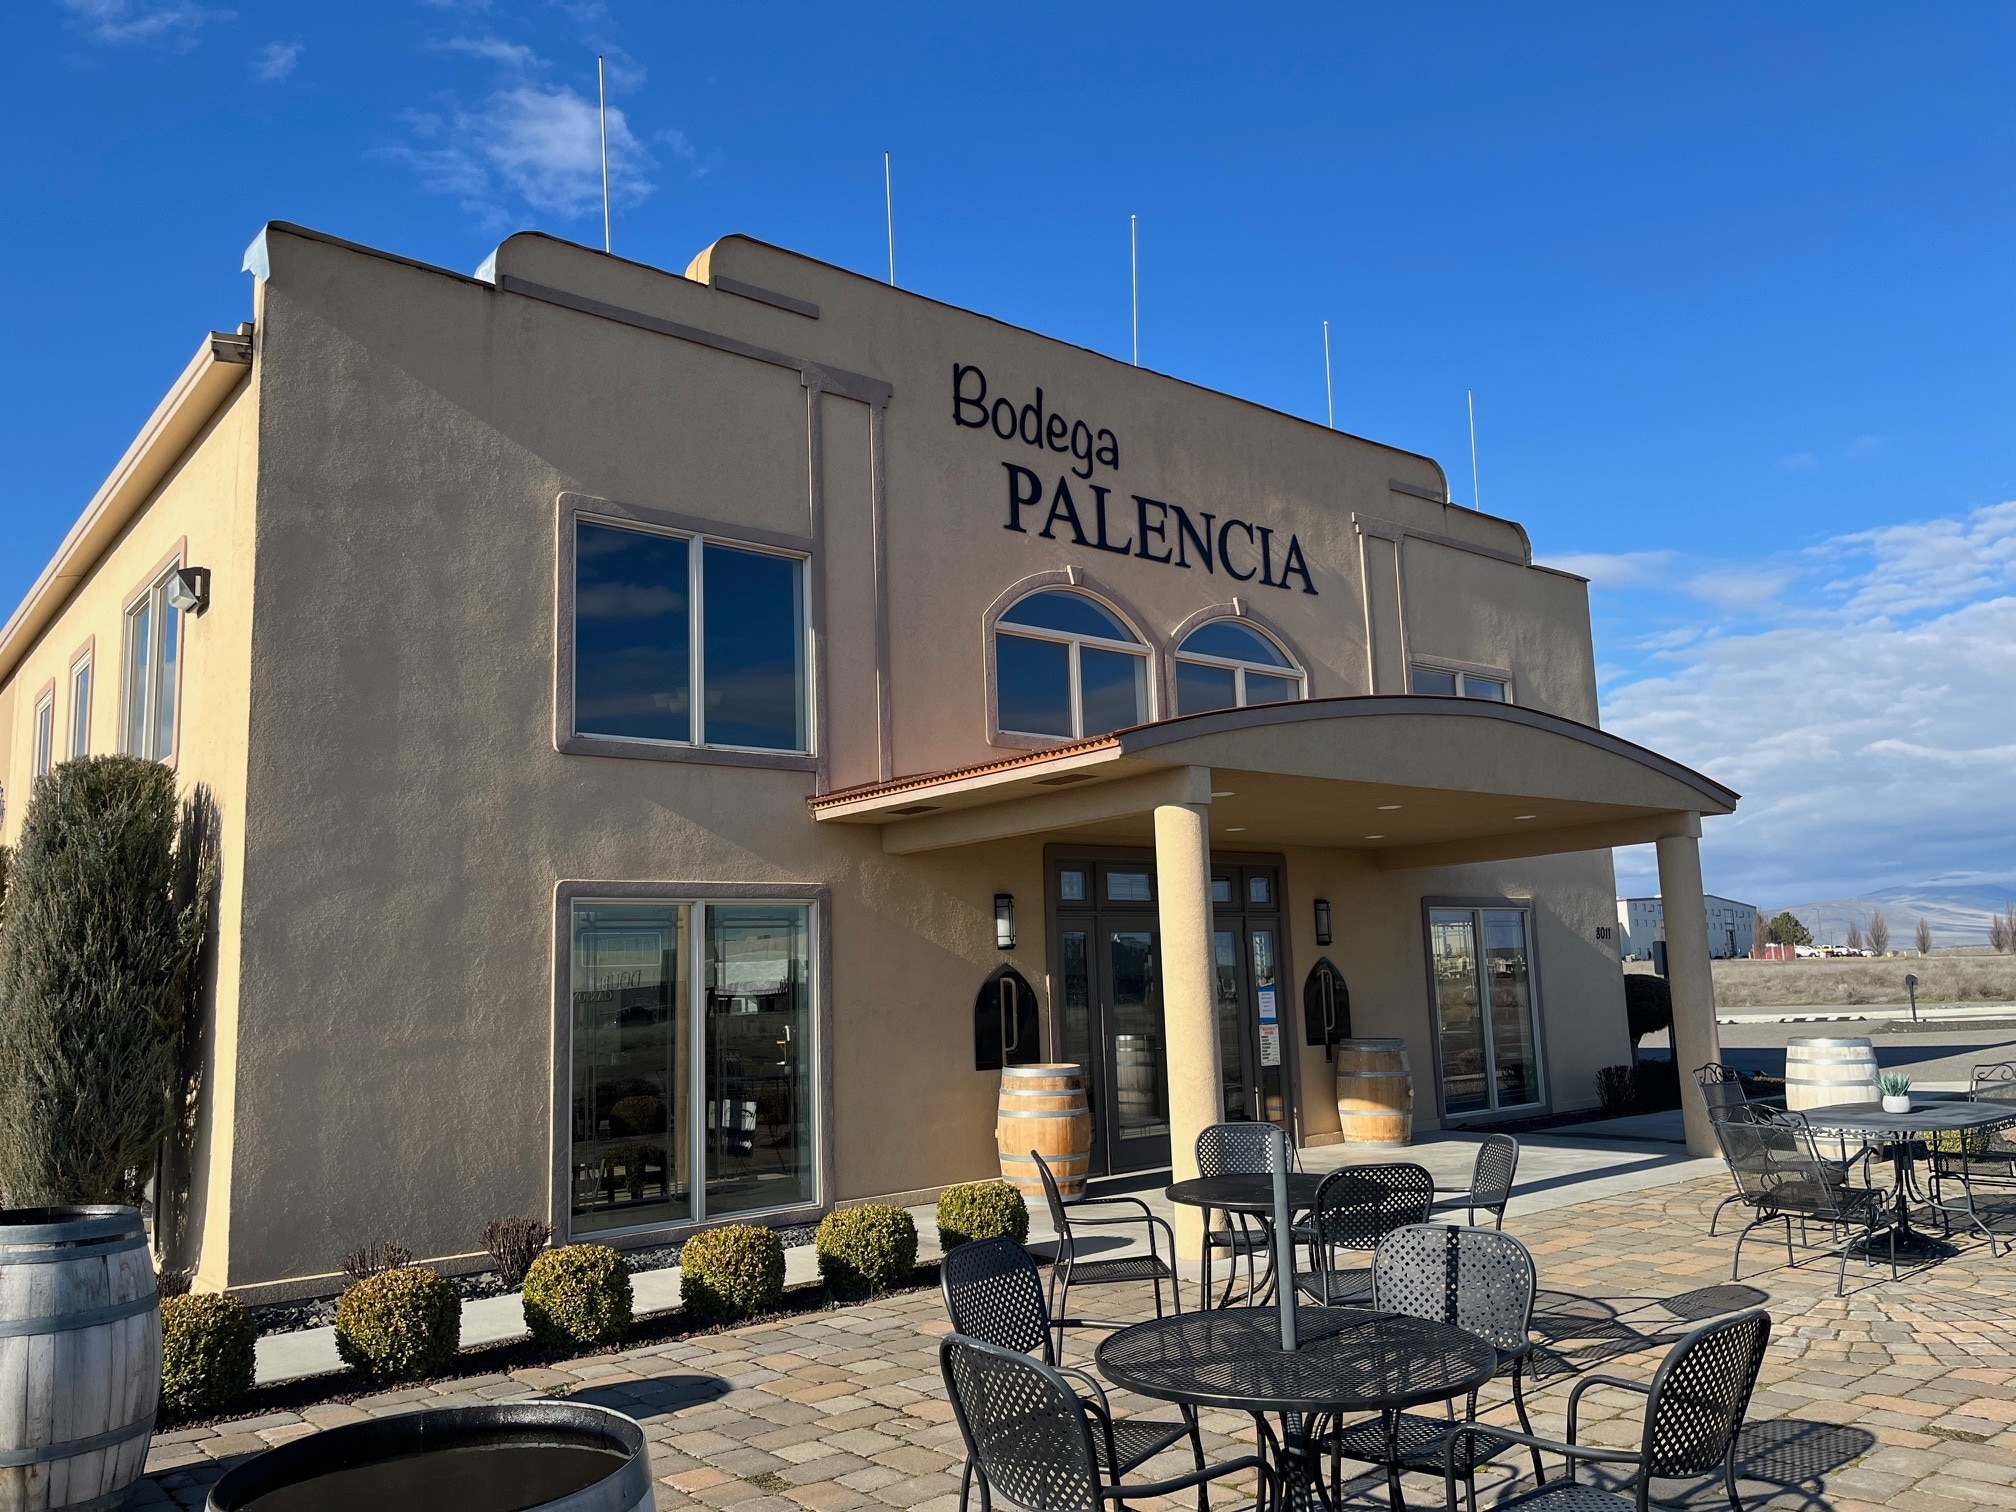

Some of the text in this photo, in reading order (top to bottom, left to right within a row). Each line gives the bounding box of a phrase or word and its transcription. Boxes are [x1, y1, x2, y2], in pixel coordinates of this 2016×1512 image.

[952, 362, 1119, 479] Bodega
[1001, 461, 1319, 595] PALENCIA
[1596, 926, 1611, 939] 8011
